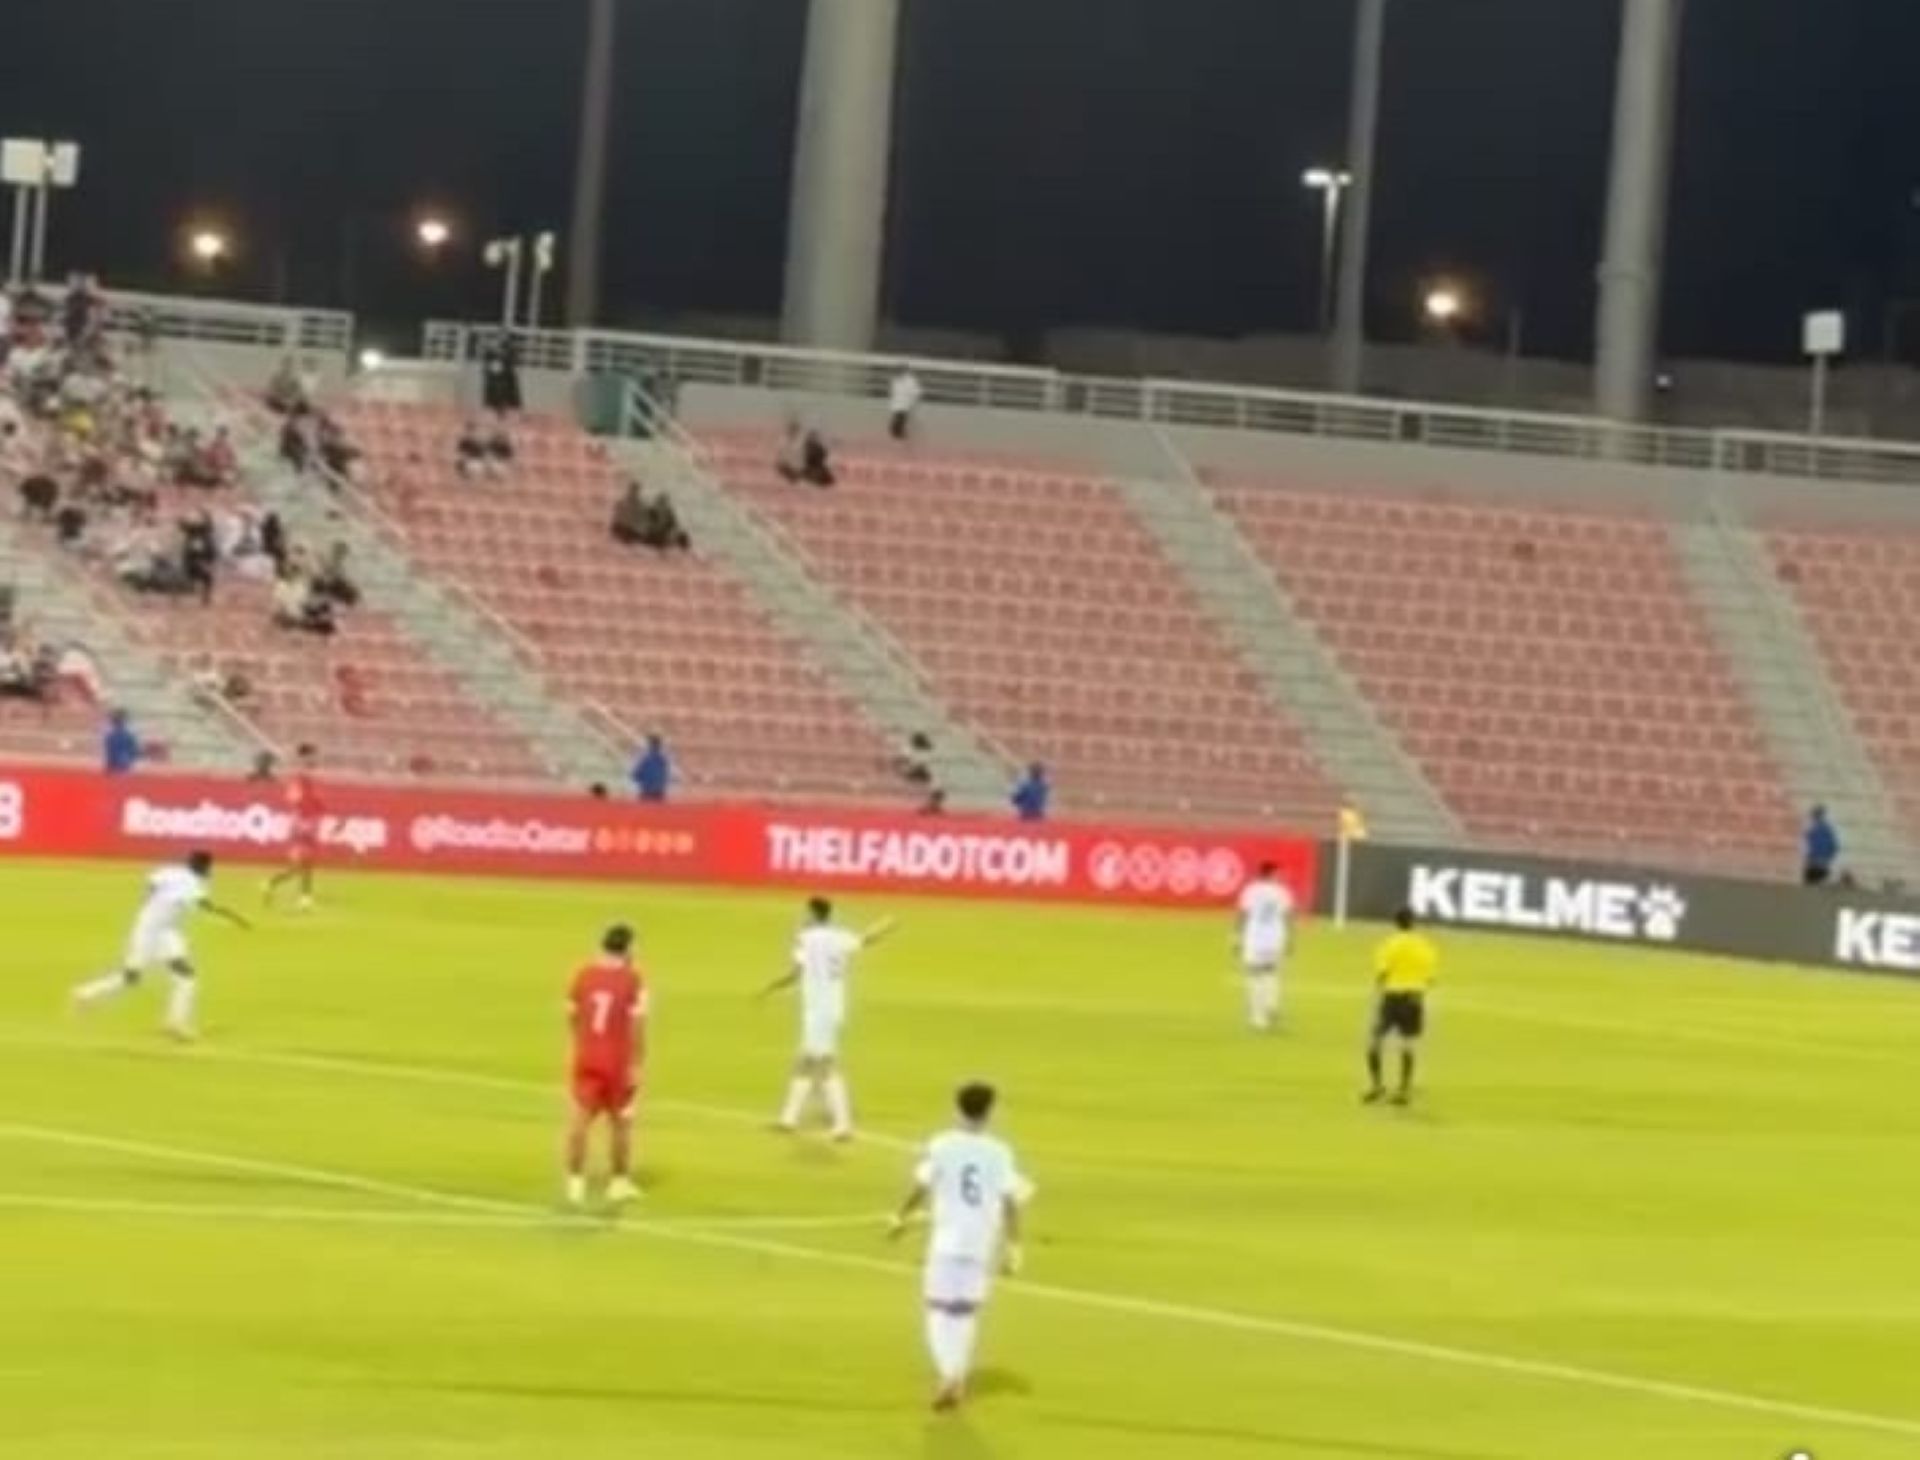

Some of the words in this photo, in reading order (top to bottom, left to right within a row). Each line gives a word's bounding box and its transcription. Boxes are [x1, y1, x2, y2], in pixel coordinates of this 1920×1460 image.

[767, 824, 1068, 885] THELFADOTCOM
[1409, 866, 1639, 936] KELME
[1836, 908, 1920, 968] KE
[591, 990, 614, 1034] 7
[961, 1164, 983, 1208] 6
